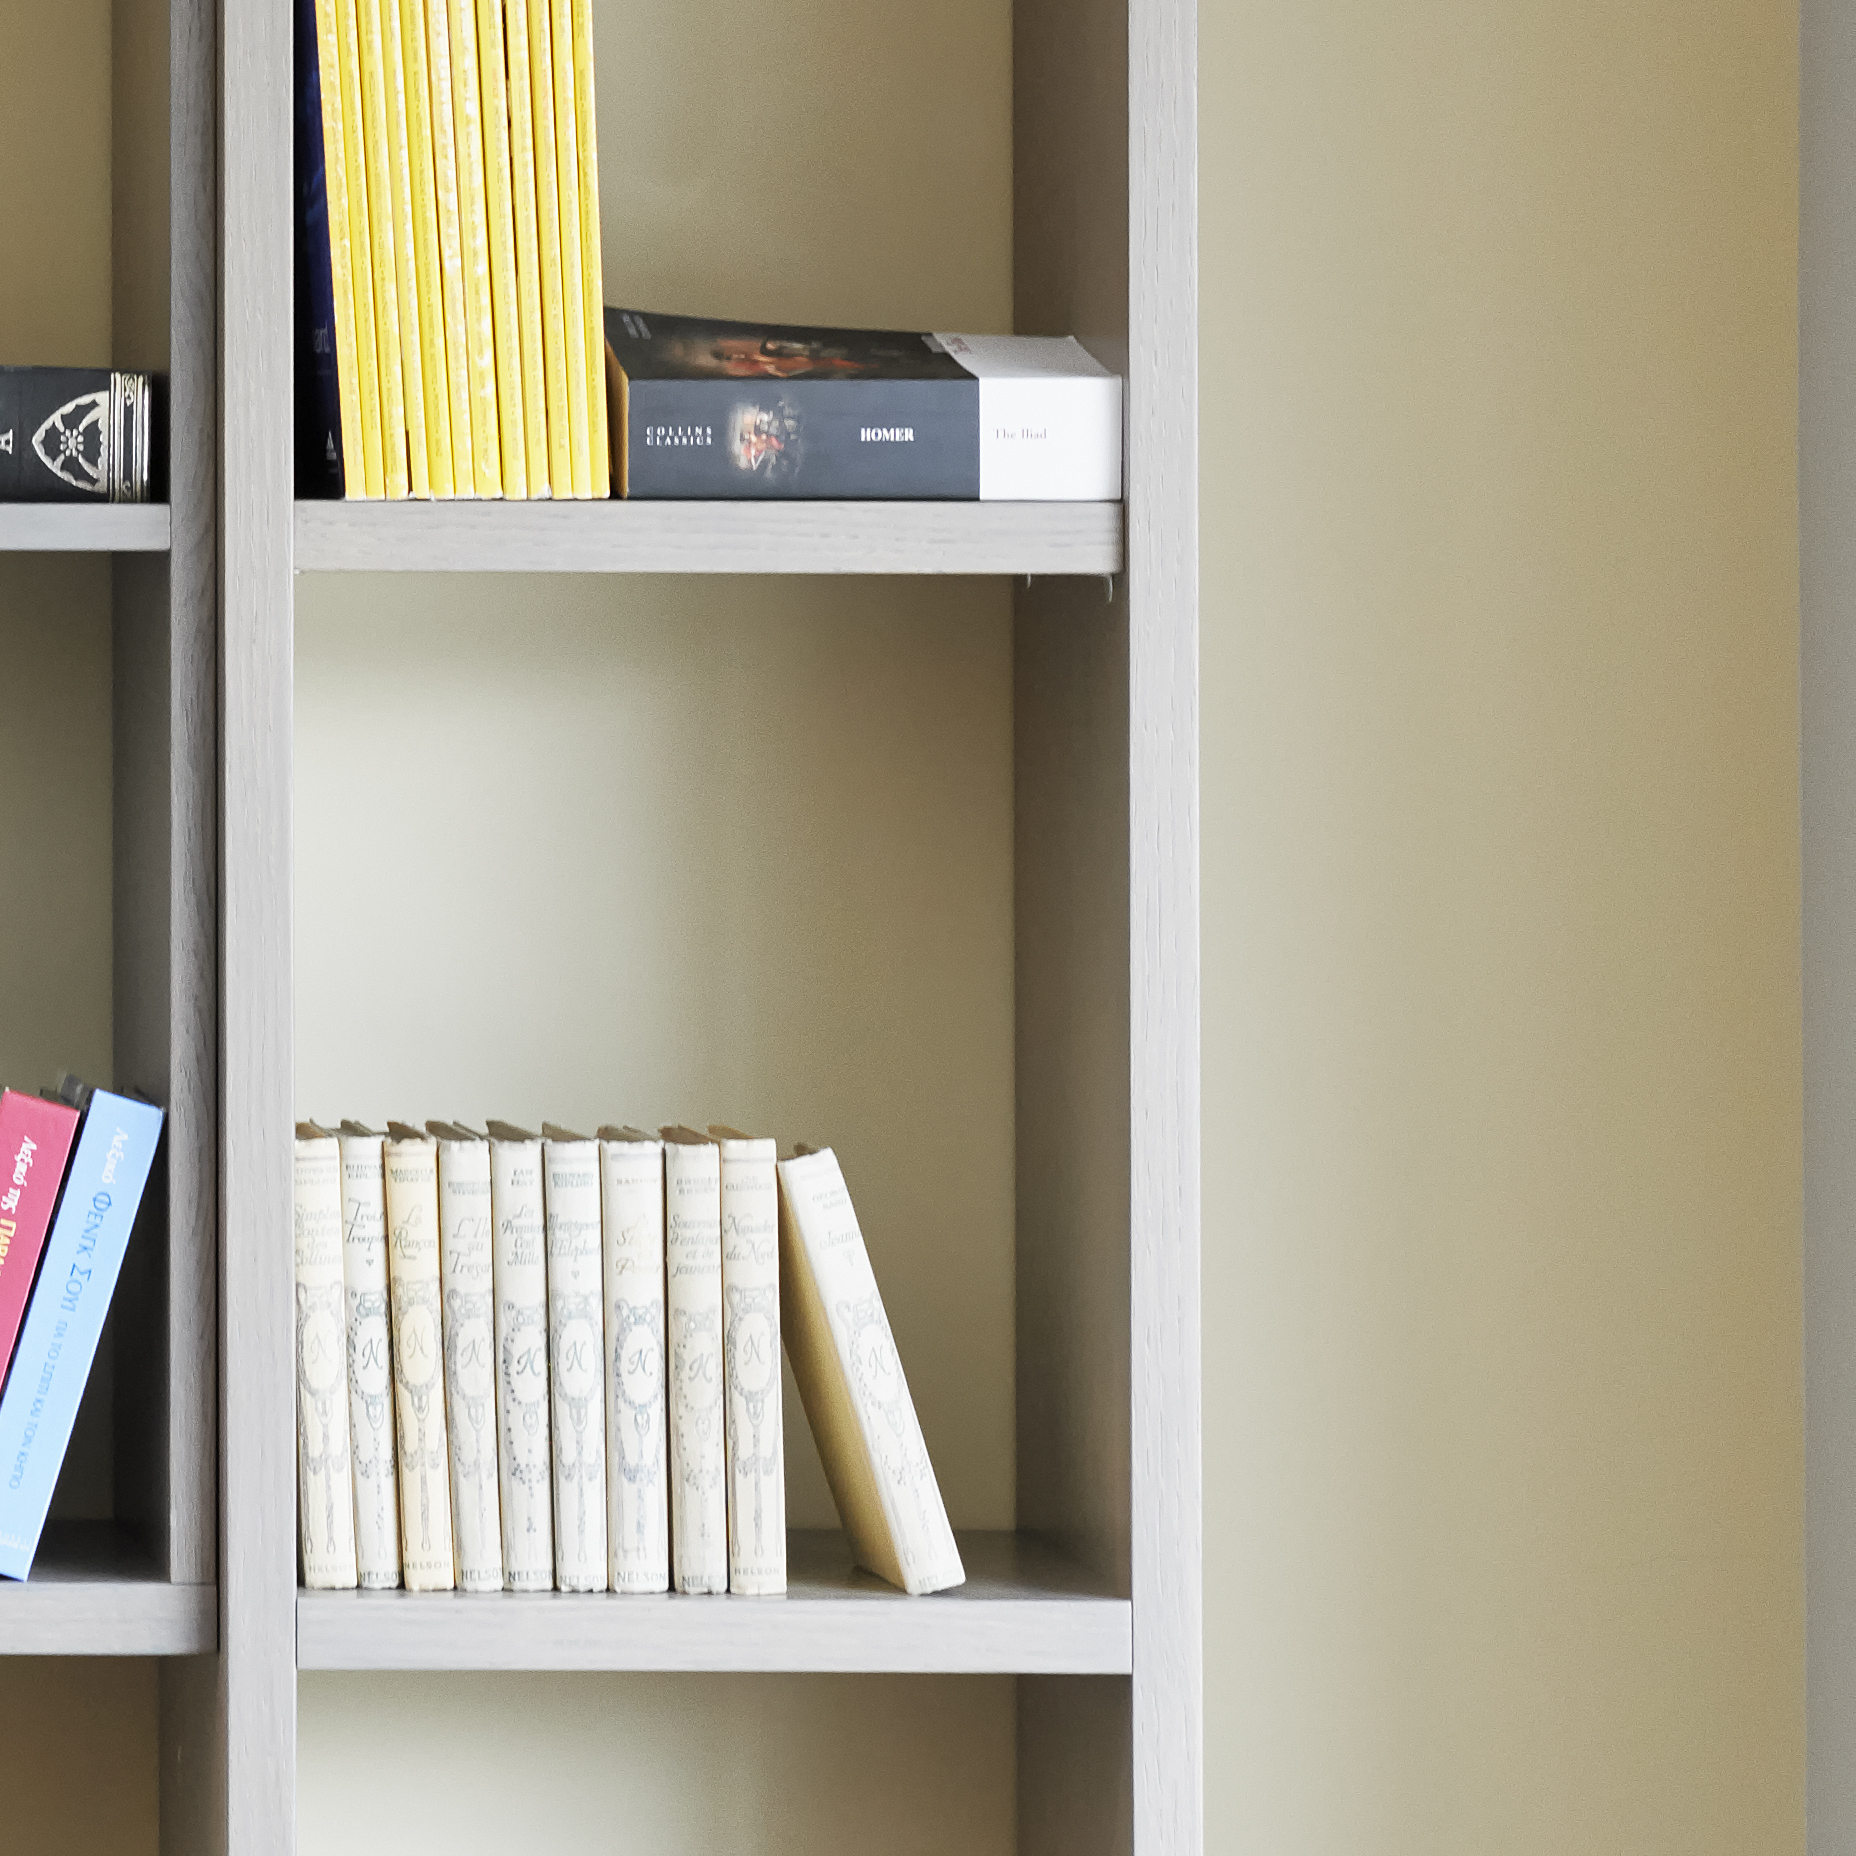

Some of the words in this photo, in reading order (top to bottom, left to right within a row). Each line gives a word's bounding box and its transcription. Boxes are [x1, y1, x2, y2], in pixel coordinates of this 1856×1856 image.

[646, 425, 713, 437] COLLINS
[860, 427, 915, 443] HOMER
[993, 428, 1016, 441] The
[1021, 428, 1048, 441] Iliad
[7, 1134, 38, 1186] Λεξικό
[99, 1126, 130, 1186] Λεξικό
[75, 1188, 115, 1260] ΦΕΝΓΚ
[59, 1262, 92, 1314] ΣΟΥΙ
[402, 1560, 451, 1572] NELSON
[507, 1569, 554, 1582] NELSON
[616, 1570, 668, 1584] NELSON
